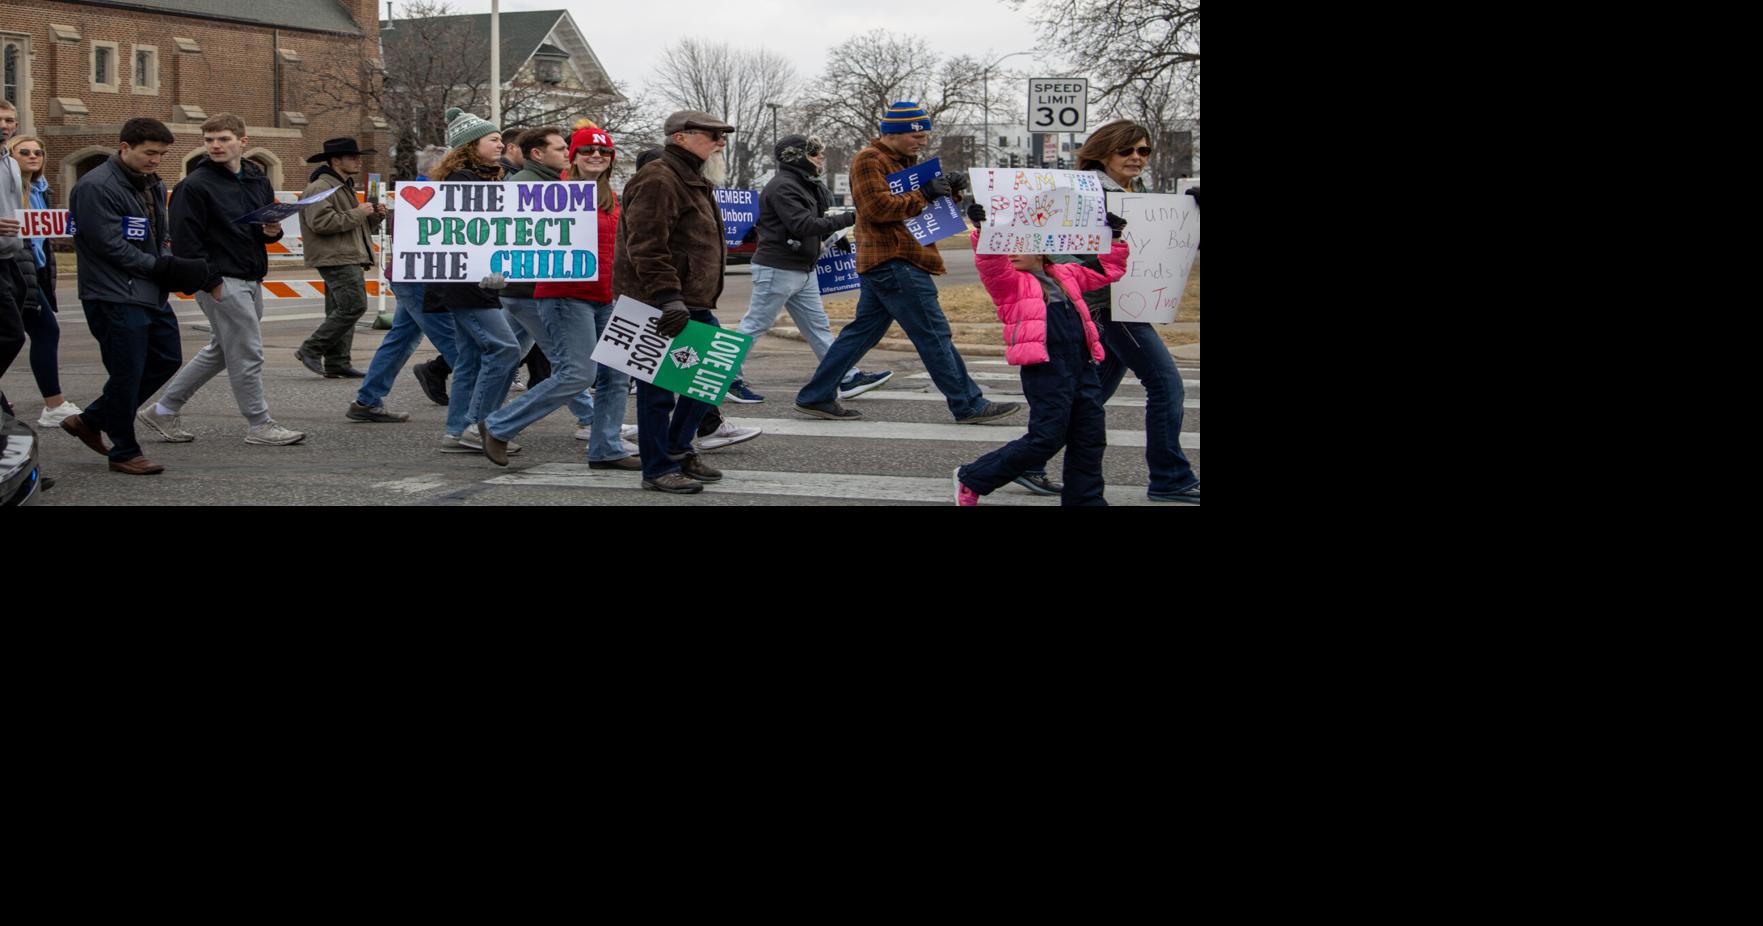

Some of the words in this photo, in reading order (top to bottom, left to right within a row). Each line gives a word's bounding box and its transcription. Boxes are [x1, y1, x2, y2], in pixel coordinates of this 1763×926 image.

[1034, 83, 1082, 93] SPEED
[1038, 95, 1077, 104] LIMIT
[1035, 106, 1079, 127] 30
[592, 133, 607, 144] N
[988, 170, 994, 191] I
[1013, 170, 1057, 191] AM
[439, 184, 505, 212] THE
[517, 183, 596, 212] MOM
[720, 208, 753, 222] Unborn
[923, 212, 940, 235] The
[1121, 196, 1190, 231] Funny
[417, 216, 575, 246] PROTECT
[989, 232, 1100, 252] GENERATION
[400, 251, 468, 280] THE
[490, 249, 597, 279] CHILD
[1131, 260, 1173, 280] Ends
[603, 315, 640, 350] LIFE
[702, 331, 745, 371] LOVE
[687, 368, 727, 401] LIFE
